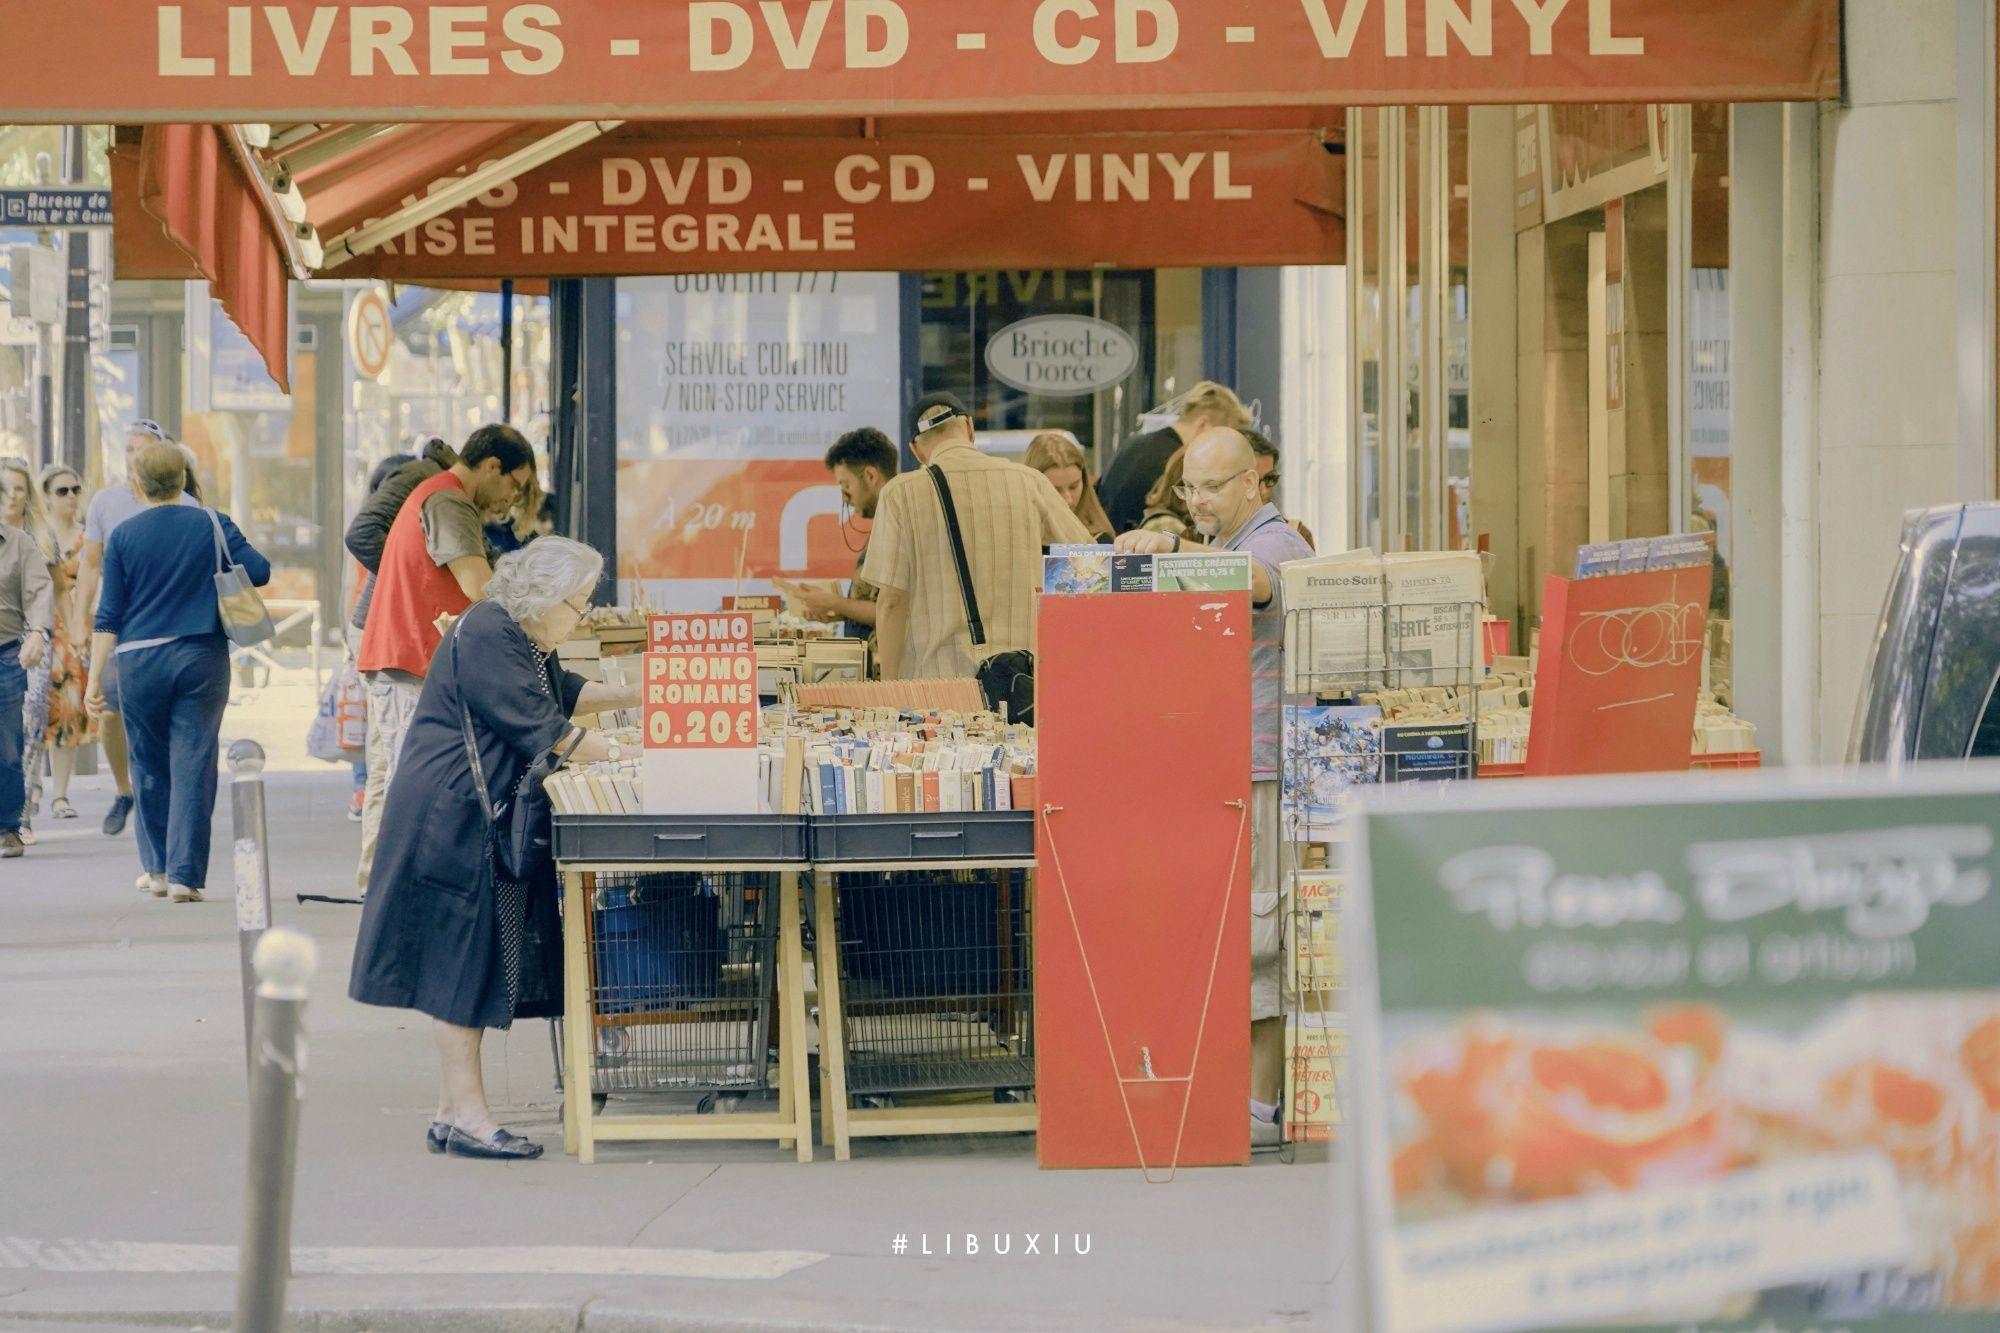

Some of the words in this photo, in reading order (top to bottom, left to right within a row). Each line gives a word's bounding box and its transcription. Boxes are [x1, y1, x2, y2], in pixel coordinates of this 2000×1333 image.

[158, 3, 564, 76] LIVRES
[610, 40, 640, 55] -
[688, 0, 910, 72] DVD
[956, 33, 986, 49] -
[1032, 0, 1180, 65] CD
[1225, 26, 1255, 43] -
[1301, 0, 1645, 58] VINYL
[602, 156, 753, 206] DVD
[834, 154, 936, 203] CD
[1016, 151, 1252, 201] VINYL
[28, 192, 82, 208] Bureau
[88, 192, 107, 208] de
[521, 213, 856, 254] INTEGRALE
[1012, 329, 1118, 358] Brioche
[665, 342, 748, 376] SERVICE
[758, 342, 848, 376] CONTINU
[679, 382, 770, 412] NON-STOP
[776, 382, 847, 412] SERVICE
[684, 503, 724, 531] 20
[731, 511, 756, 530] m
[1197, 568, 1208, 576] DE
[653, 617, 748, 641] PROMO
[649, 657, 752, 680] PROMO
[649, 684, 752, 704] ROMANS
[650, 710, 752, 744] 0.20€
